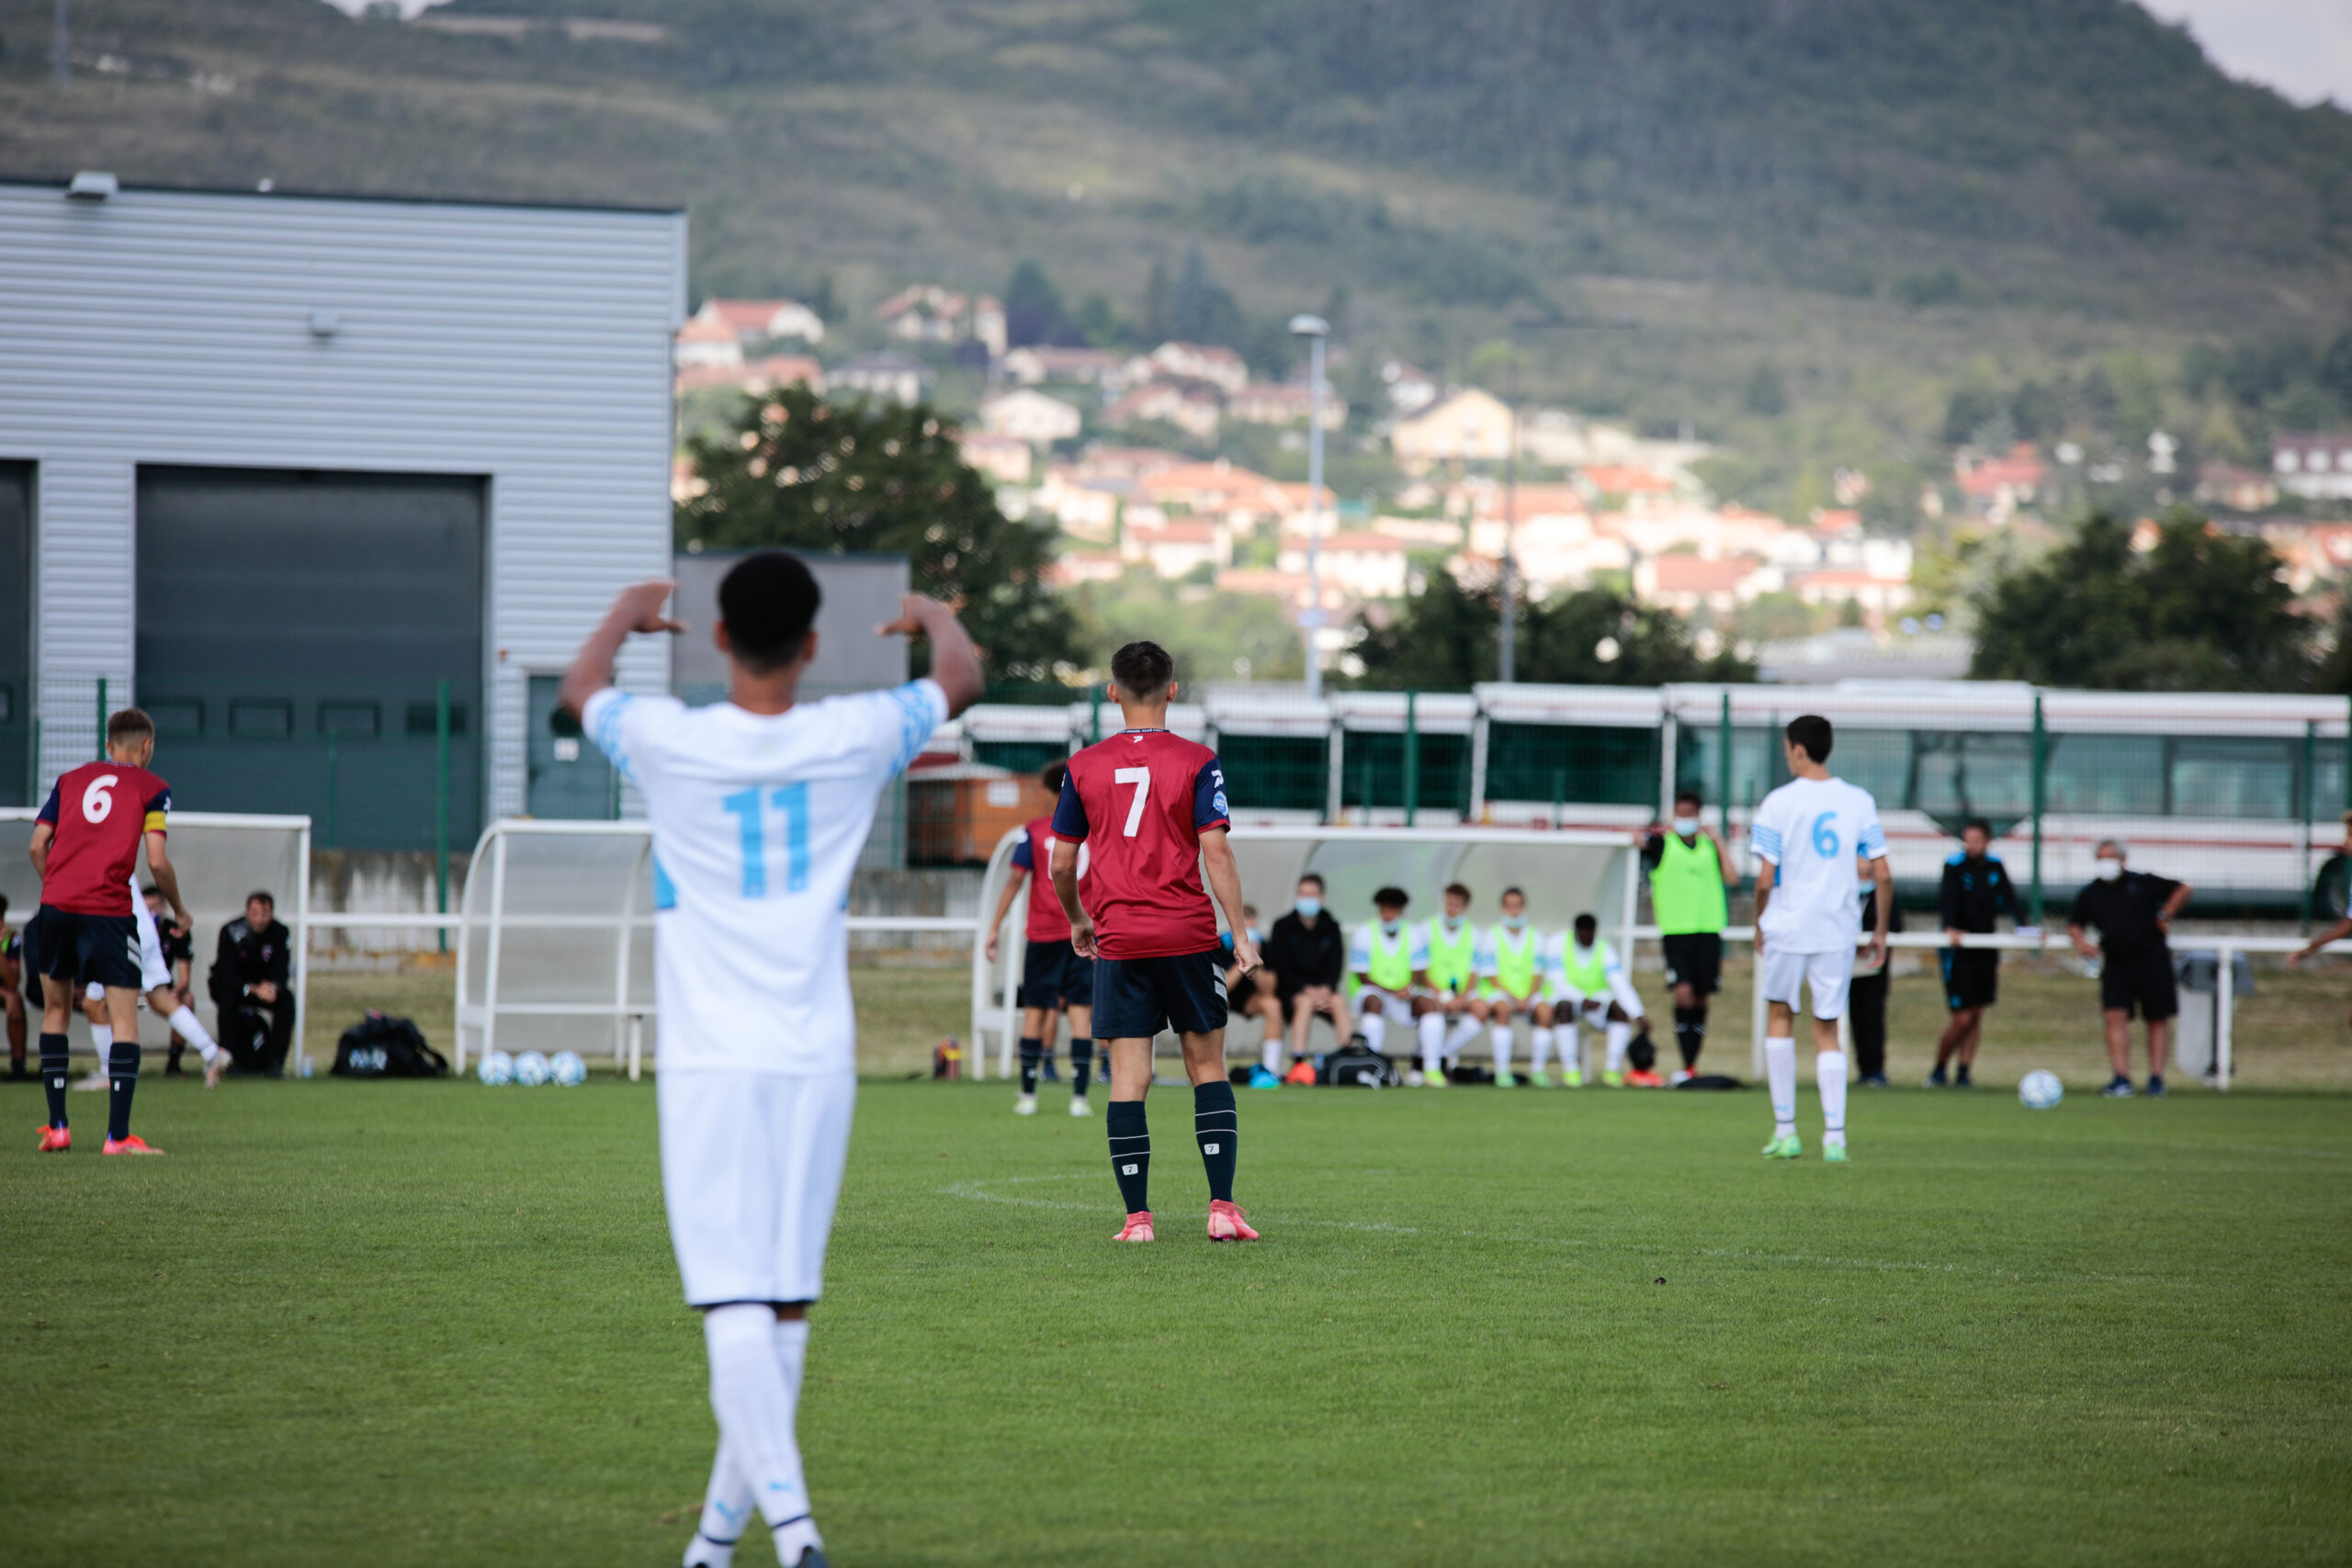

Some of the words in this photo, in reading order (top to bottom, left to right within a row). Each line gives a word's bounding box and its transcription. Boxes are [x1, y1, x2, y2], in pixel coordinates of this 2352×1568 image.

[82, 774, 119, 824] 6
[1114, 766, 1150, 837] 7
[723, 781, 809, 898] 11
[1813, 811, 1840, 860] 6
